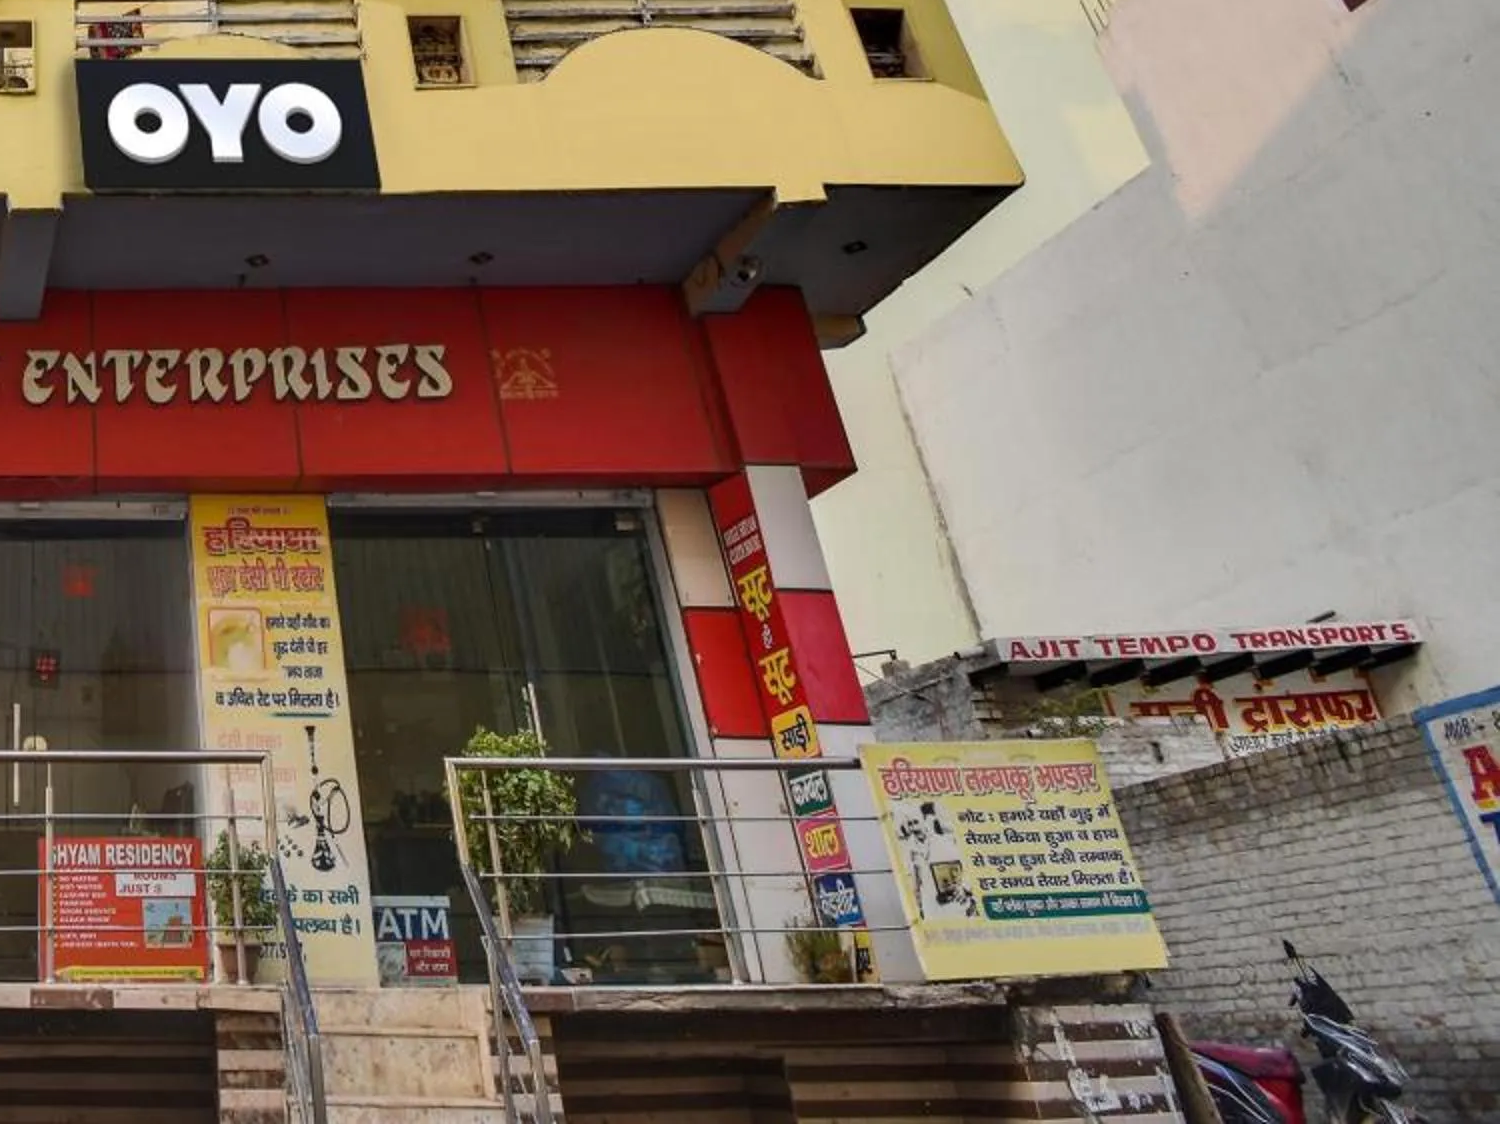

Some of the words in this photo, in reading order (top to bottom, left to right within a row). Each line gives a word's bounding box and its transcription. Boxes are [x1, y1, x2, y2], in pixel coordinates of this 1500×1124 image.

[107, 82, 343, 164] OYO
[21, 343, 454, 405] ENTERPRISES
[738, 565, 773, 621] सूट
[1010, 639, 1081, 660] AJIT
[1093, 633, 1217, 656] TEMPO
[759, 647, 796, 705] सूट
[878, 757, 964, 800] हरियाणा
[1000, 807, 1035, 824] हमारे
[1004, 828, 1041, 844] किया
[105, 843, 193, 866] RESIDENCY
[302, 889, 324, 904] का
[326, 885, 359, 904] सभी
[978, 877, 997, 890] हर
[378, 907, 449, 940] ATM
